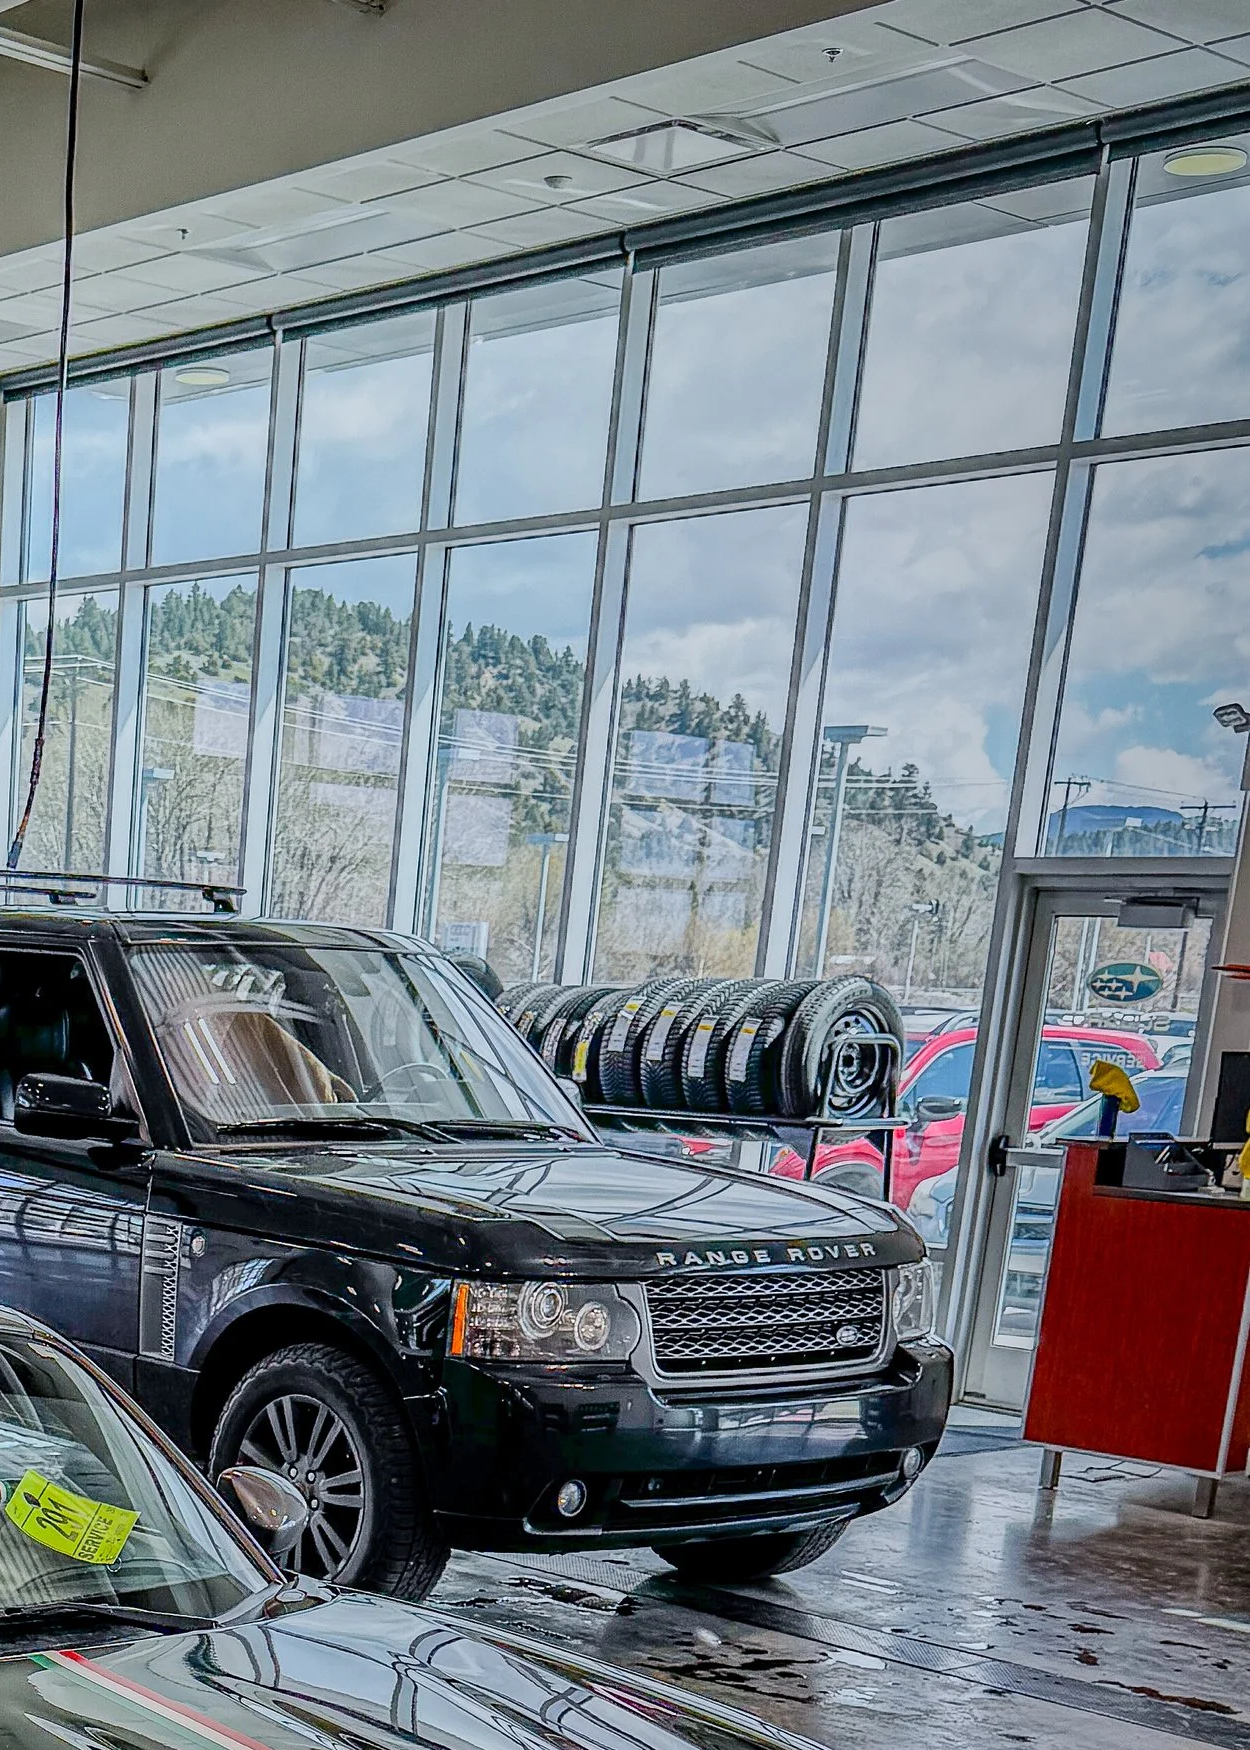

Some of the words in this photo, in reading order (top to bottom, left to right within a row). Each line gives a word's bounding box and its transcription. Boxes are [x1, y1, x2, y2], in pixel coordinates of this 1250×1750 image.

[656, 1249, 771, 1266] RANGE
[787, 1242, 876, 1262] ROVER
[37, 1497, 84, 1543] 291
[77, 1515, 114, 1561] SERVICE
